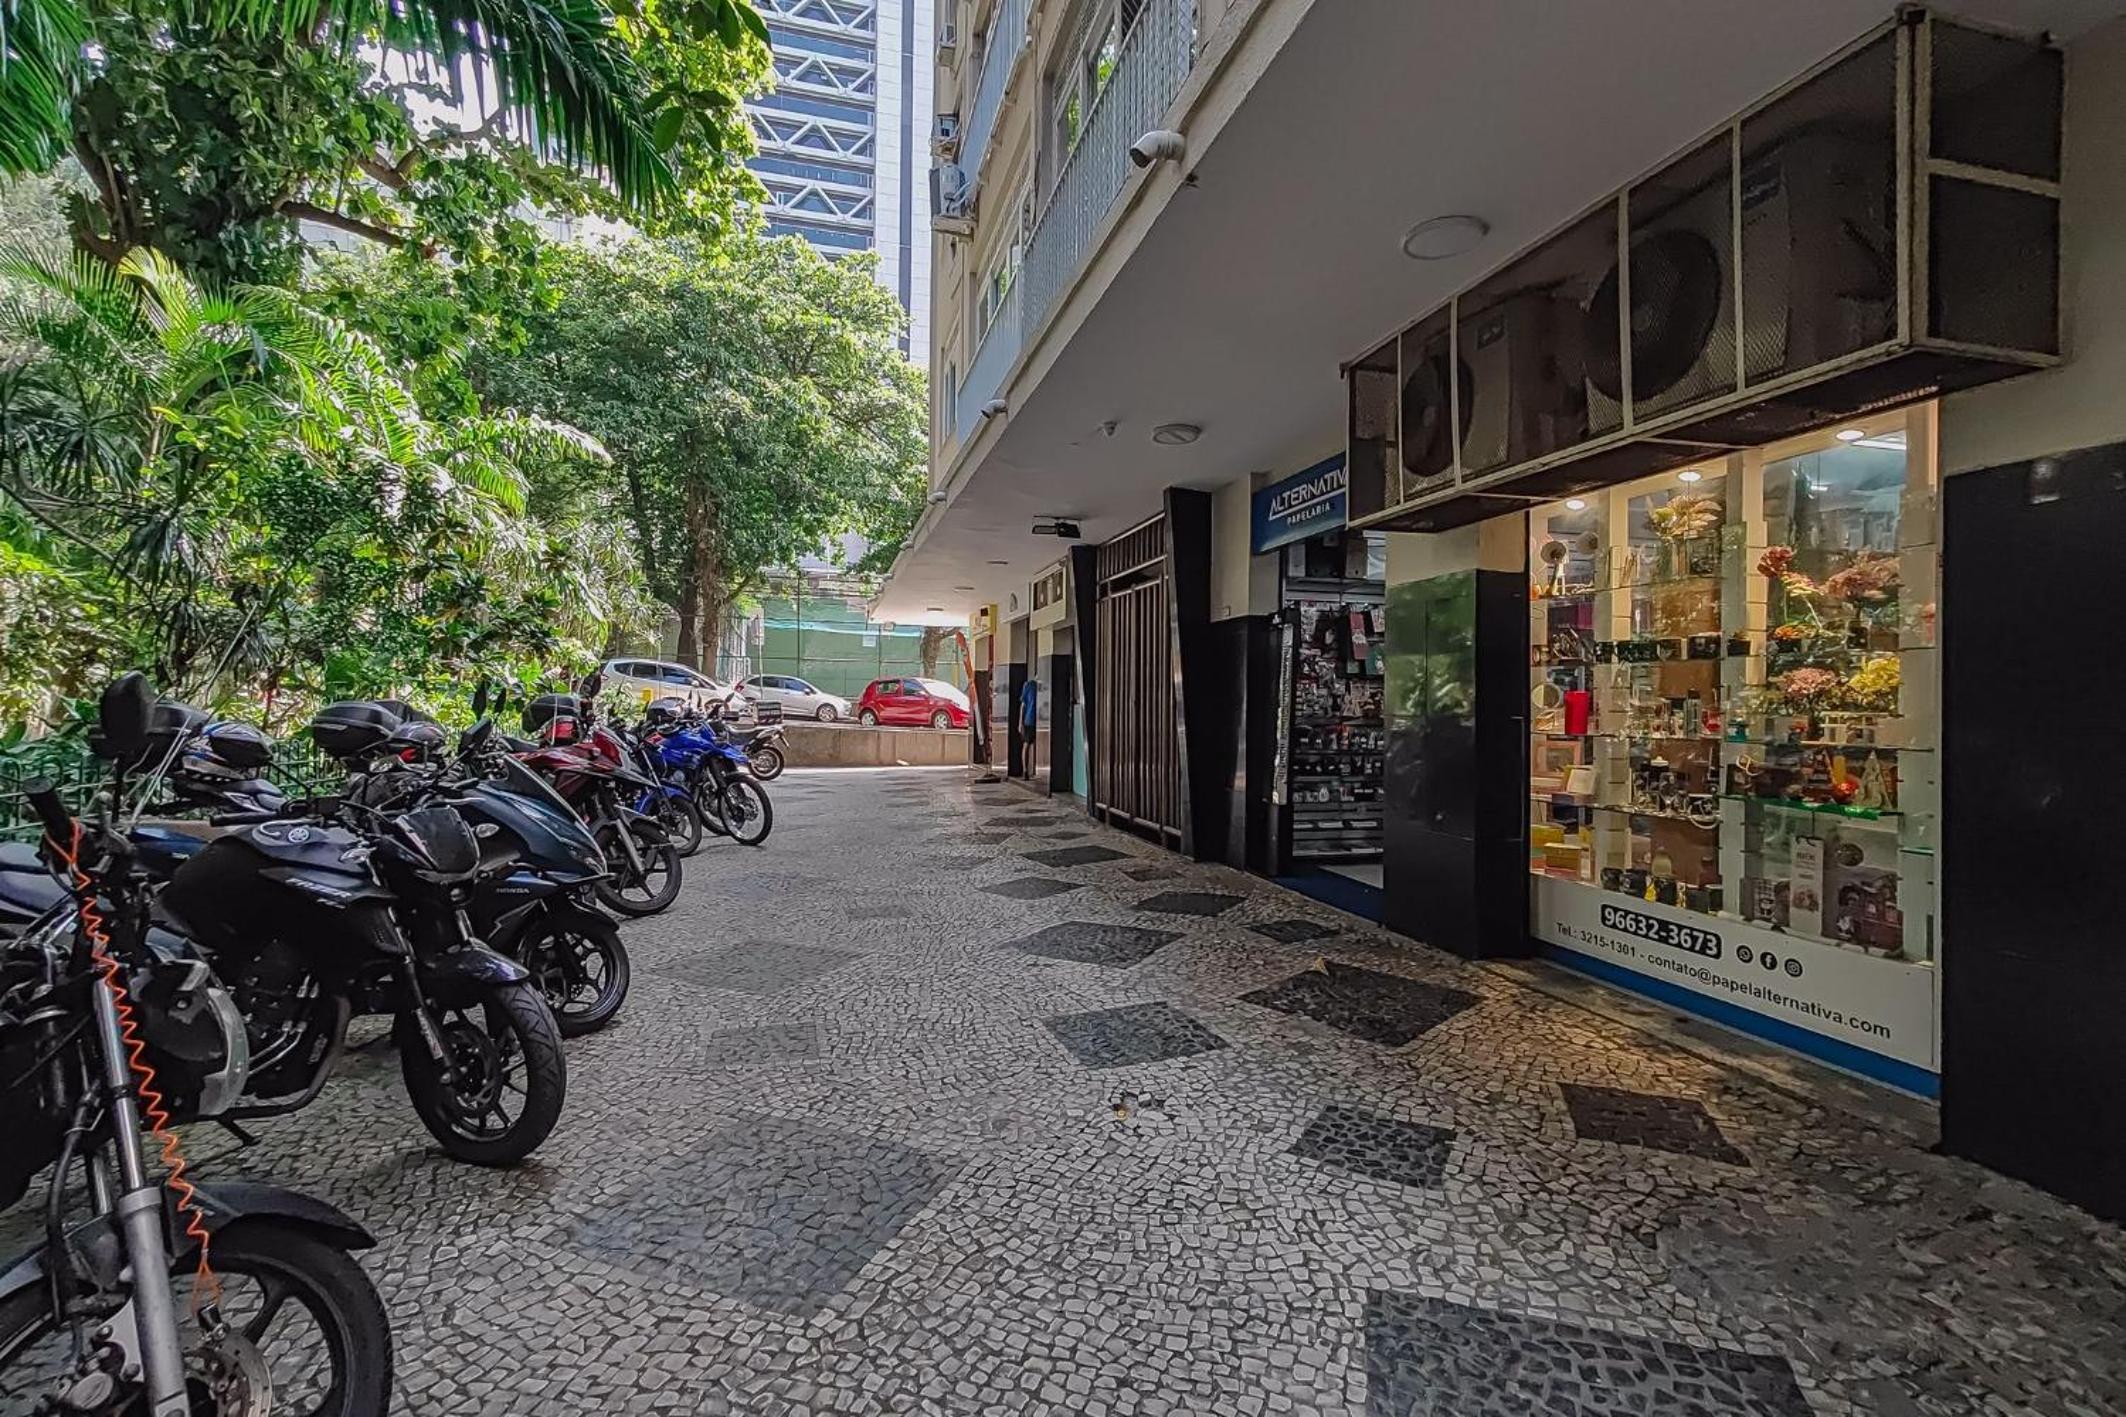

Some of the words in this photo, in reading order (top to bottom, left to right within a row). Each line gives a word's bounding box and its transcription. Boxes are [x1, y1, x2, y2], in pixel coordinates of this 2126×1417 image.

[1269, 466, 1347, 520] ALTERNATIV
[1286, 501, 1331, 526] PAPELARIA
[1604, 907, 1719, 956] 96632-3673
[1580, 930, 1636, 958] 3215-1301
[1647, 953, 1891, 1039] contato@papelalternativa.com
